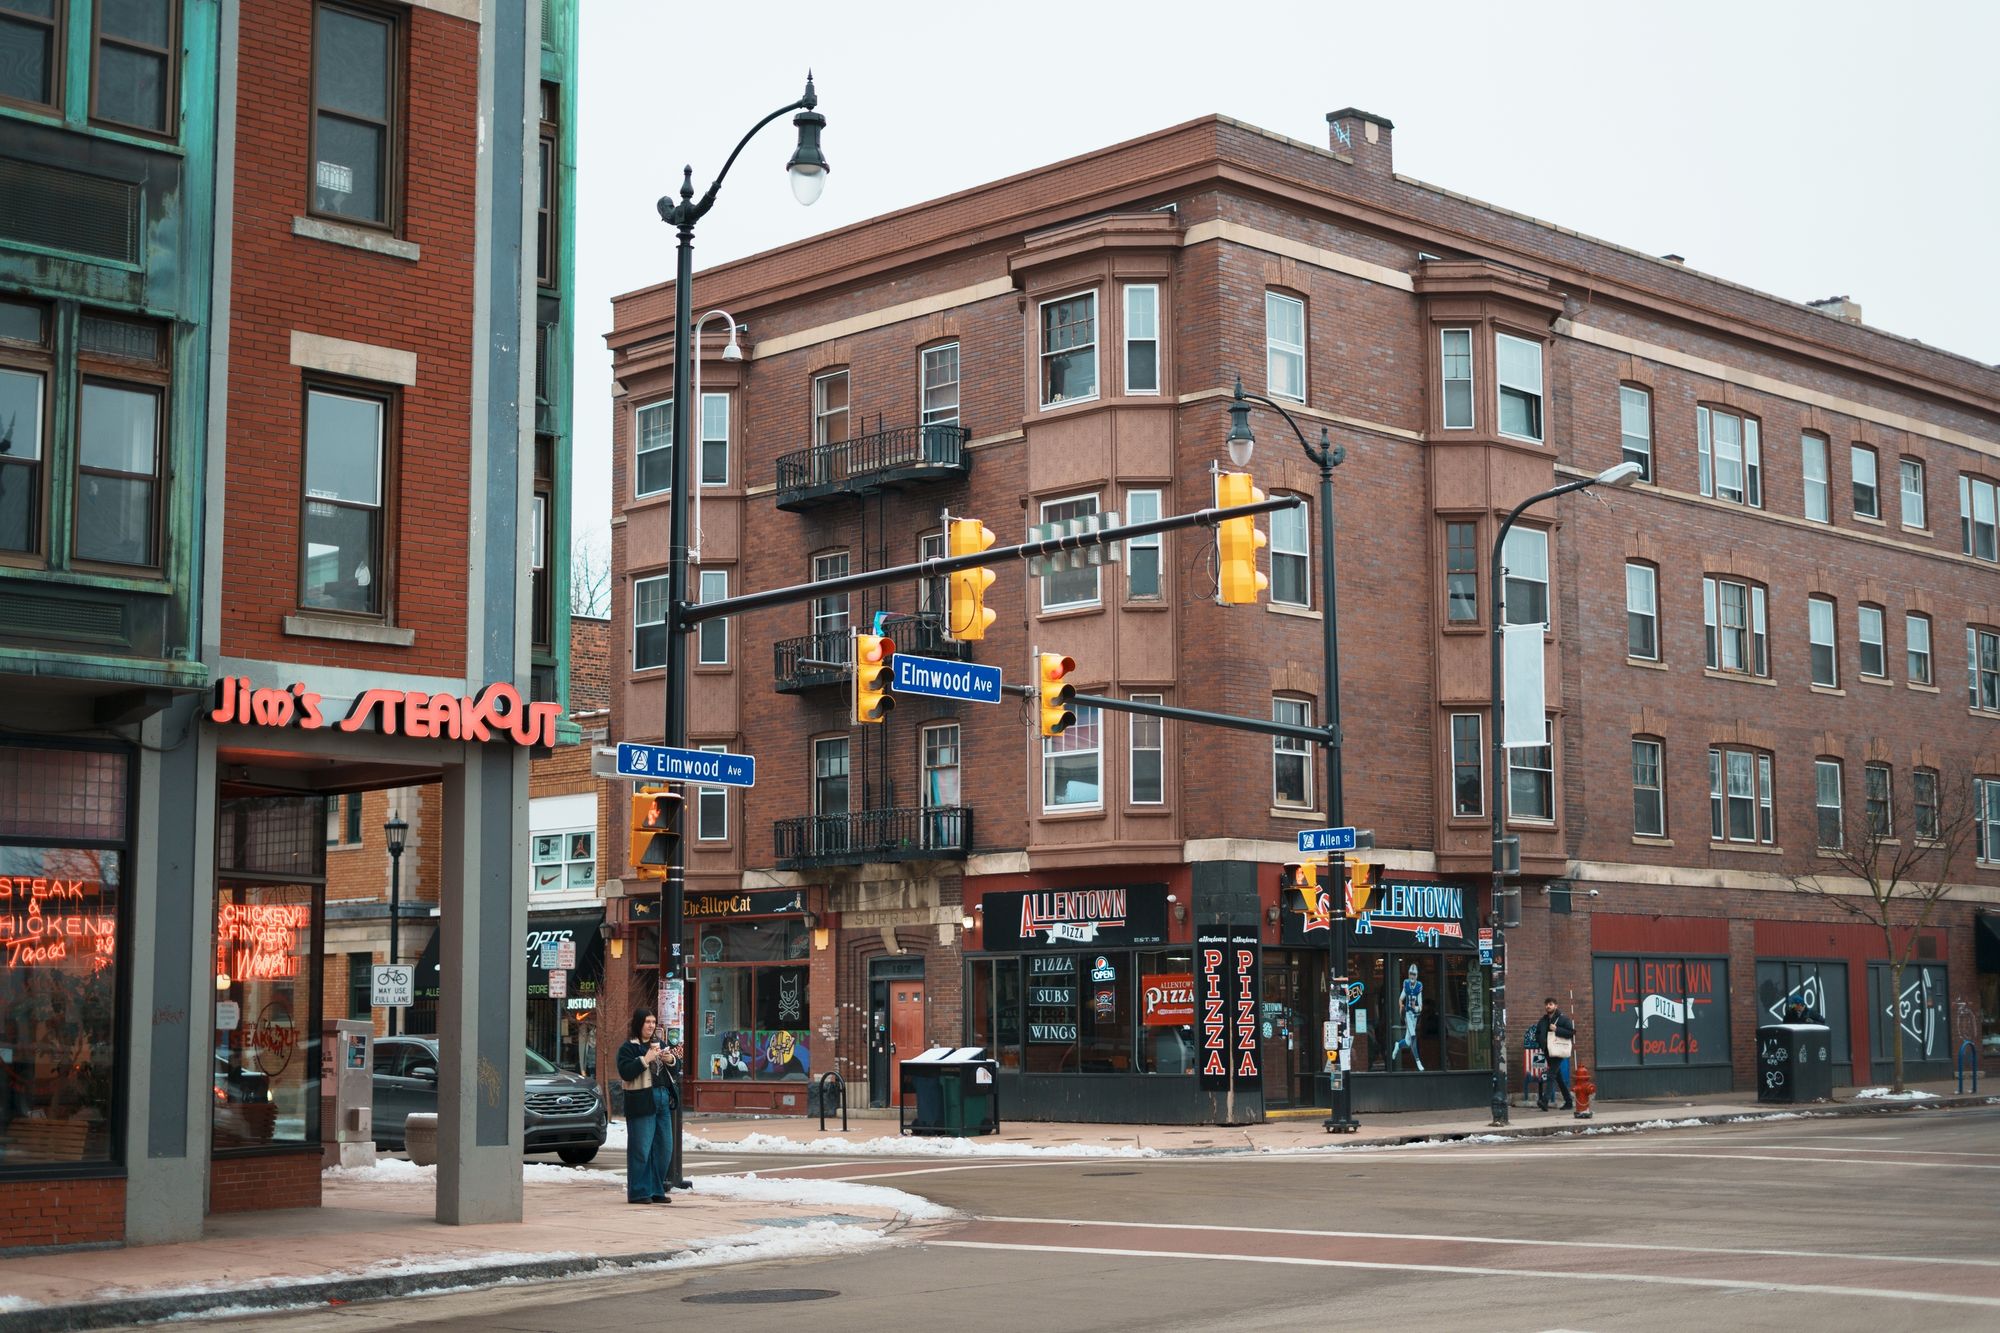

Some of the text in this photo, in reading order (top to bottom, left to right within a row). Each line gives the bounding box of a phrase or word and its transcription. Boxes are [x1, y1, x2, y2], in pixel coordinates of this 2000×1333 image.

[902, 662, 993, 693] Elmwood Ave
[211, 676, 563, 748] Jim's STEAKOUT
[657, 753, 719, 777] Elmwood
[727, 765, 742, 776] Ave
[1319, 834, 1350, 847] Allen St
[0, 877, 83, 899] STEAK
[28, 897, 41, 914] &
[682, 895, 751, 917] The Alley Cat
[1020, 889, 1127, 938] ALLENTOWN
[1355, 884, 1463, 934] ALENTOWN
[0, 915, 101, 935] HICKEN
[854, 910, 923, 926] SURREY
[229, 924, 288, 942] FINGER
[1062, 925, 1084, 939] PIZZA
[1444, 923, 1461, 935] PIZZA
[527, 930, 573, 951] ORTS
[6, 936, 66, 968] Tacos
[1482, 950, 1490, 958] 20
[1034, 957, 1075, 972] PIZZA
[1093, 970, 1113, 980] OPEN
[425, 987, 440, 997] ALLE
[528, 985, 548, 994] STORE
[580, 981, 595, 990] 201
[1347, 986, 1363, 999] PEN
[1611, 962, 1713, 1013] ALLENTOWN
[567, 998, 582, 1009] JUST
[582, 998, 593, 1009] DO
[1036, 989, 1069, 1003] SUBS
[1145, 987, 1194, 1014] PIZZA
[1204, 949, 1226, 1076] PIZZA
[1237, 950, 1258, 1077] PIZZA
[1262, 1003, 1283, 1012] ENTOWN
[1655, 997, 1676, 1019] PIZZA
[1031, 1025, 1077, 1039] WINGS
[1631, 1033, 1668, 1056] Open
